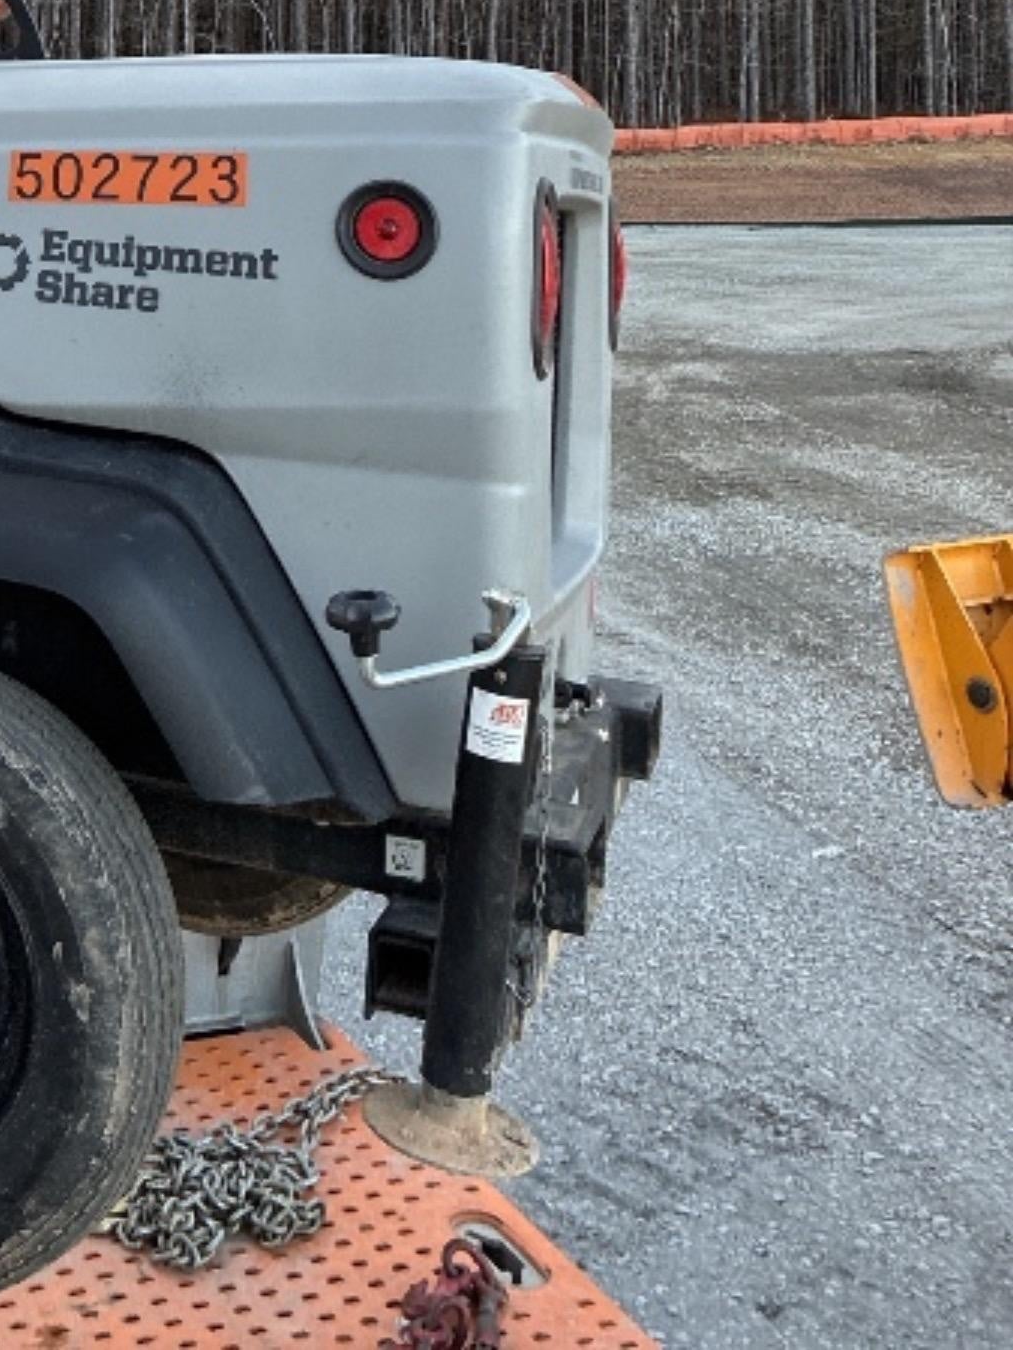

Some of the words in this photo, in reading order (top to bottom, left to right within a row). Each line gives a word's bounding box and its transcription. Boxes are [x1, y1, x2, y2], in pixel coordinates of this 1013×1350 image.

[14, 151, 240, 203] 502723
[39, 227, 279, 280] Equipment
[34, 269, 160, 312] Share
